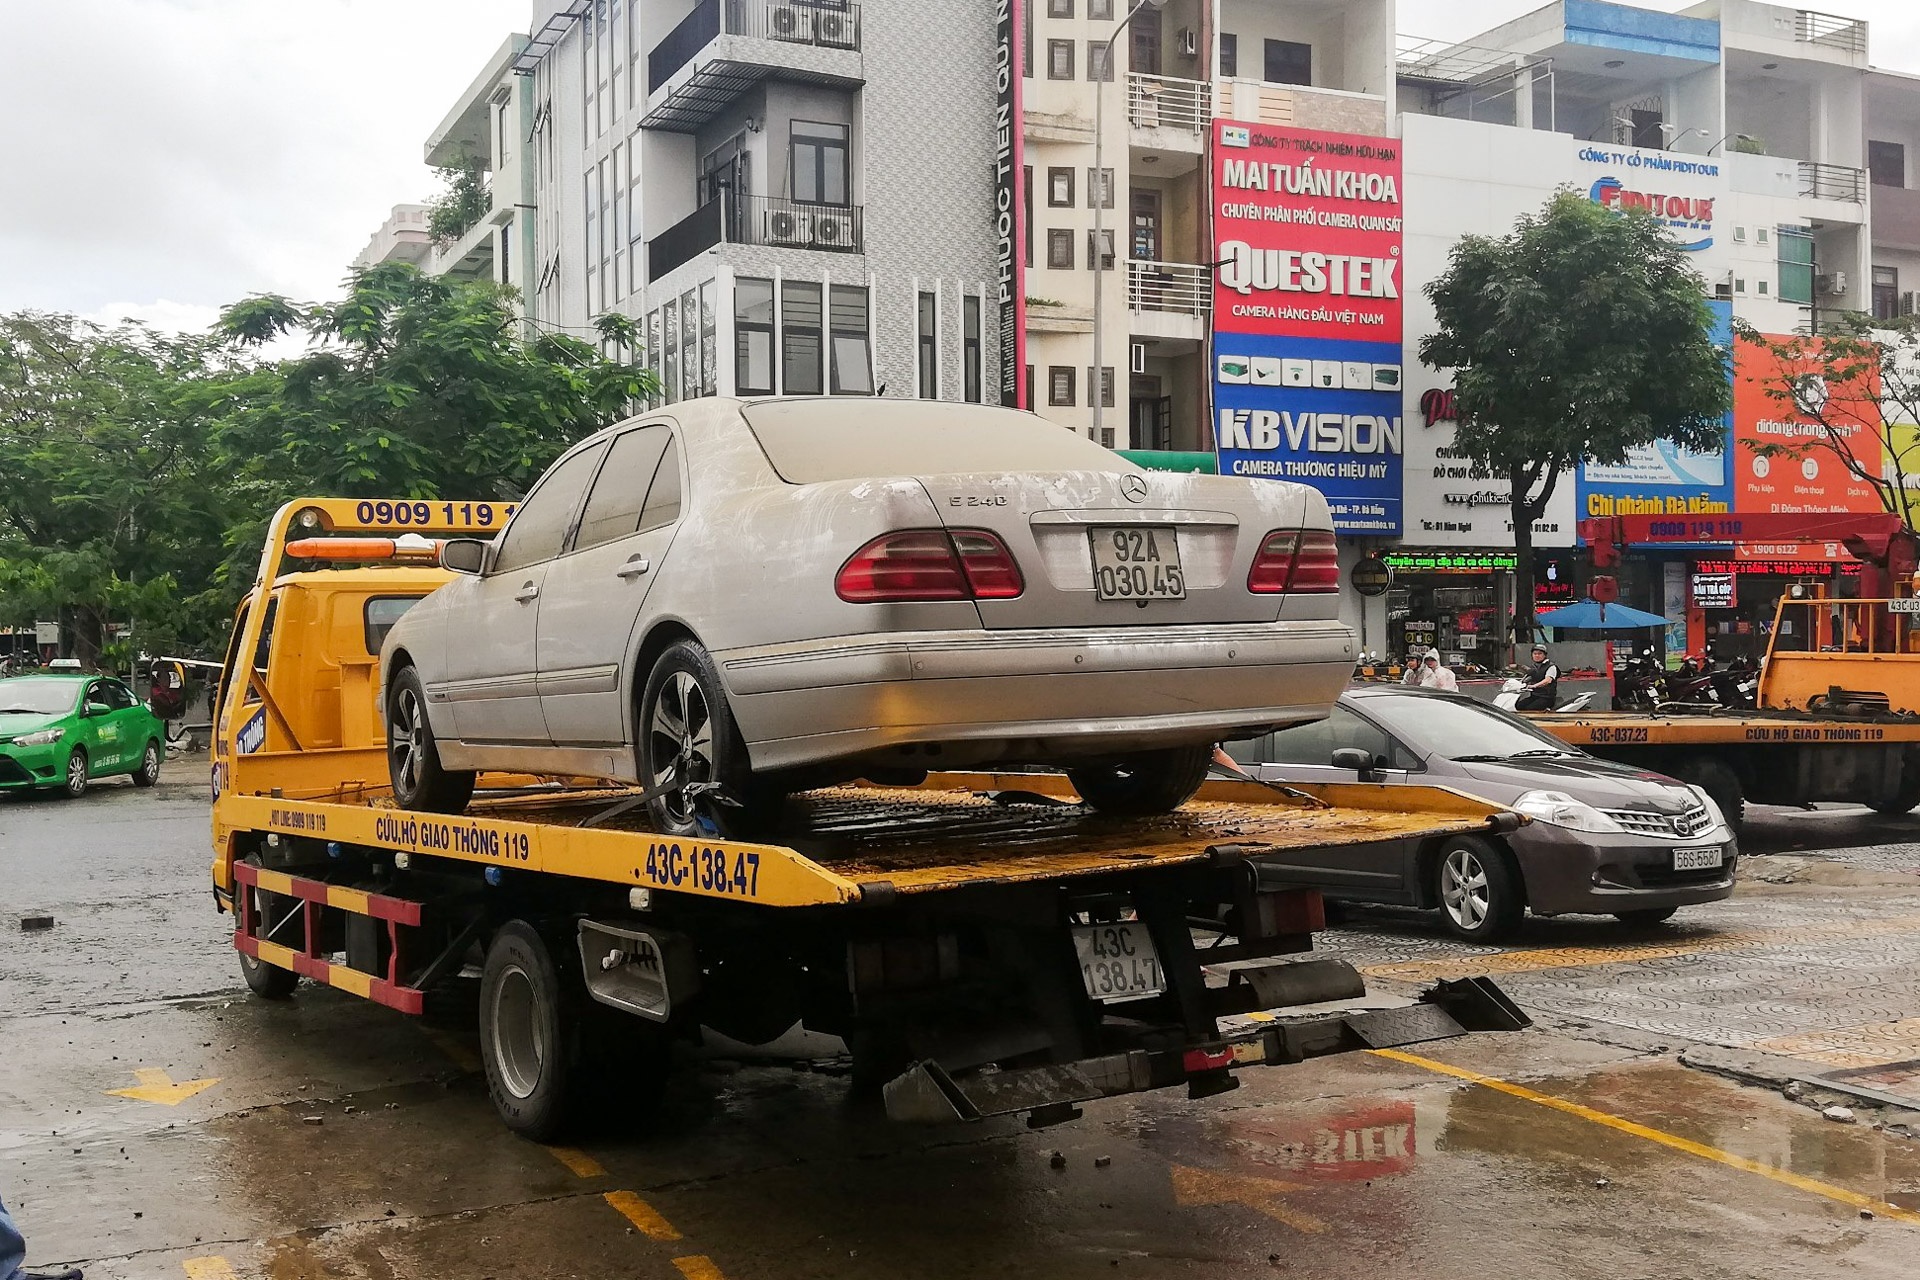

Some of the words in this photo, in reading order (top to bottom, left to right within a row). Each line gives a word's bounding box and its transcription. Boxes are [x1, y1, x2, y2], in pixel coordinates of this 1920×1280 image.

[997, 102, 1010, 183] TIEN
[1251, 133, 1278, 148] CÔNG
[1280, 138, 1291, 149] TY
[1293, 138, 1323, 152] TRÁCH
[1326, 141, 1353, 157] NHIỆM
[1377, 148, 1396, 162] HẠN
[1579, 147, 1609, 164] CÔNG
[1611, 153, 1624, 165] TY
[1627, 150, 1641, 167] CỔ
[1643, 153, 1672, 171] PHẦN
[1673, 160, 1719, 177] FIDITOUR
[1223, 158, 1268, 192] MAI
[1270, 156, 1332, 198] TUẤN
[1336, 170, 1399, 203] KHOA
[1222, 202, 1262, 220] CHUYÊN
[1264, 207, 1291, 224] PHÂN
[1293, 206, 1317, 225] PHỐI
[1318, 211, 1358, 229] CAMERA
[1359, 216, 1385, 231] QUAN
[1386, 215, 1402, 232] SÁT
[1219, 240, 1399, 299] QUESTEK
[1232, 304, 1276, 319] CAMERA
[1278, 305, 1309, 322] HÀNG
[1311, 306, 1332, 323] ĐẦU
[1334, 309, 1356, 326] VIỆT
[1359, 313, 1384, 325] NAM
[1220, 408, 1402, 454] KBVISION
[1233, 460, 1283, 475] CAMERA
[1285, 460, 1336, 477] THƯƠNG
[1338, 460, 1366, 480] HIỆU
[1369, 461, 1387, 478] MỸ
[1433, 463, 1446, 478] ĐỒ
[1448, 466, 1466, 479] CHƠI
[949, 496, 963, 506] E
[968, 494, 1008, 506] 240
[1748, 483, 1760, 493] Phụ
[357, 501, 430, 525] 0909
[442, 502, 493, 526] 119
[1588, 493, 1613, 516] Chi
[1616, 494, 1663, 514] nhánh
[1666, 496, 1687, 514] Đà
[1113, 530, 1160, 563] 92A
[1753, 544, 1775, 554] 1900
[1777, 545, 1798, 555] 6122
[1416, 558, 1435, 568] cung
[1100, 565, 1182, 598] 030.45
[1590, 727, 1648, 743] 43C-037.23
[1746, 727, 1771, 740] CỨU
[1773, 725, 1789, 743] HỘ
[1793, 728, 1820, 741] GIAO
[1824, 726, 1861, 740] THÔNG
[1864, 728, 1883, 740] 119
[306, 813, 315, 830] 119
[316, 814, 326, 831] 119
[376, 813, 399, 843] CỨU
[401, 815, 417, 851] HỘ
[421, 824, 449, 851] GIAO
[453, 822, 499, 857] THÔNG
[503, 832, 529, 861] 119
[646, 843, 760, 896] 43C-138.47
[1676, 849, 1719, 868] 56S-5587
[1092, 926, 1136, 960] 43C
[1083, 957, 1158, 994] 138.47
